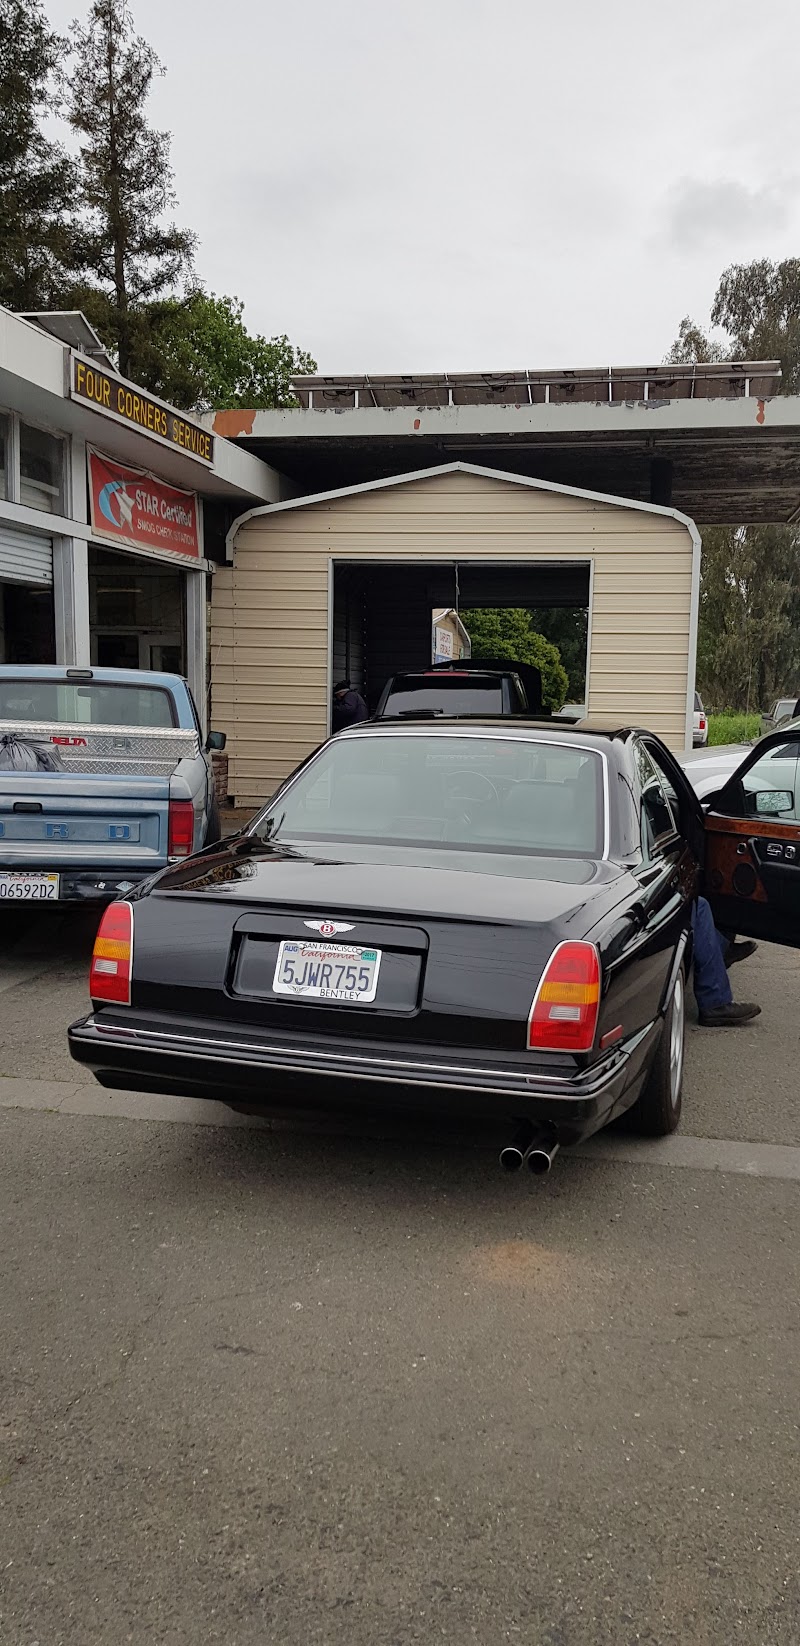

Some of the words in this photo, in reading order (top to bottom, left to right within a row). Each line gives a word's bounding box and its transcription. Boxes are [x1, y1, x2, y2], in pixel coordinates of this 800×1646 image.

[77, 364, 111, 407] FOUR
[117, 388, 167, 436] CORNERS
[172, 420, 211, 459] SERVICE
[135, 489, 159, 517] STAR
[137, 519, 156, 534] SMOG
[0, 883, 55, 898] 06592D2
[284, 945, 299, 953] AUG
[304, 942, 318, 950] SAN
[319, 944, 358, 953] FRANCISCO
[301, 949, 361, 962] California
[282, 959, 370, 992] 5JWR755
[320, 988, 361, 1000] BENTLEY
